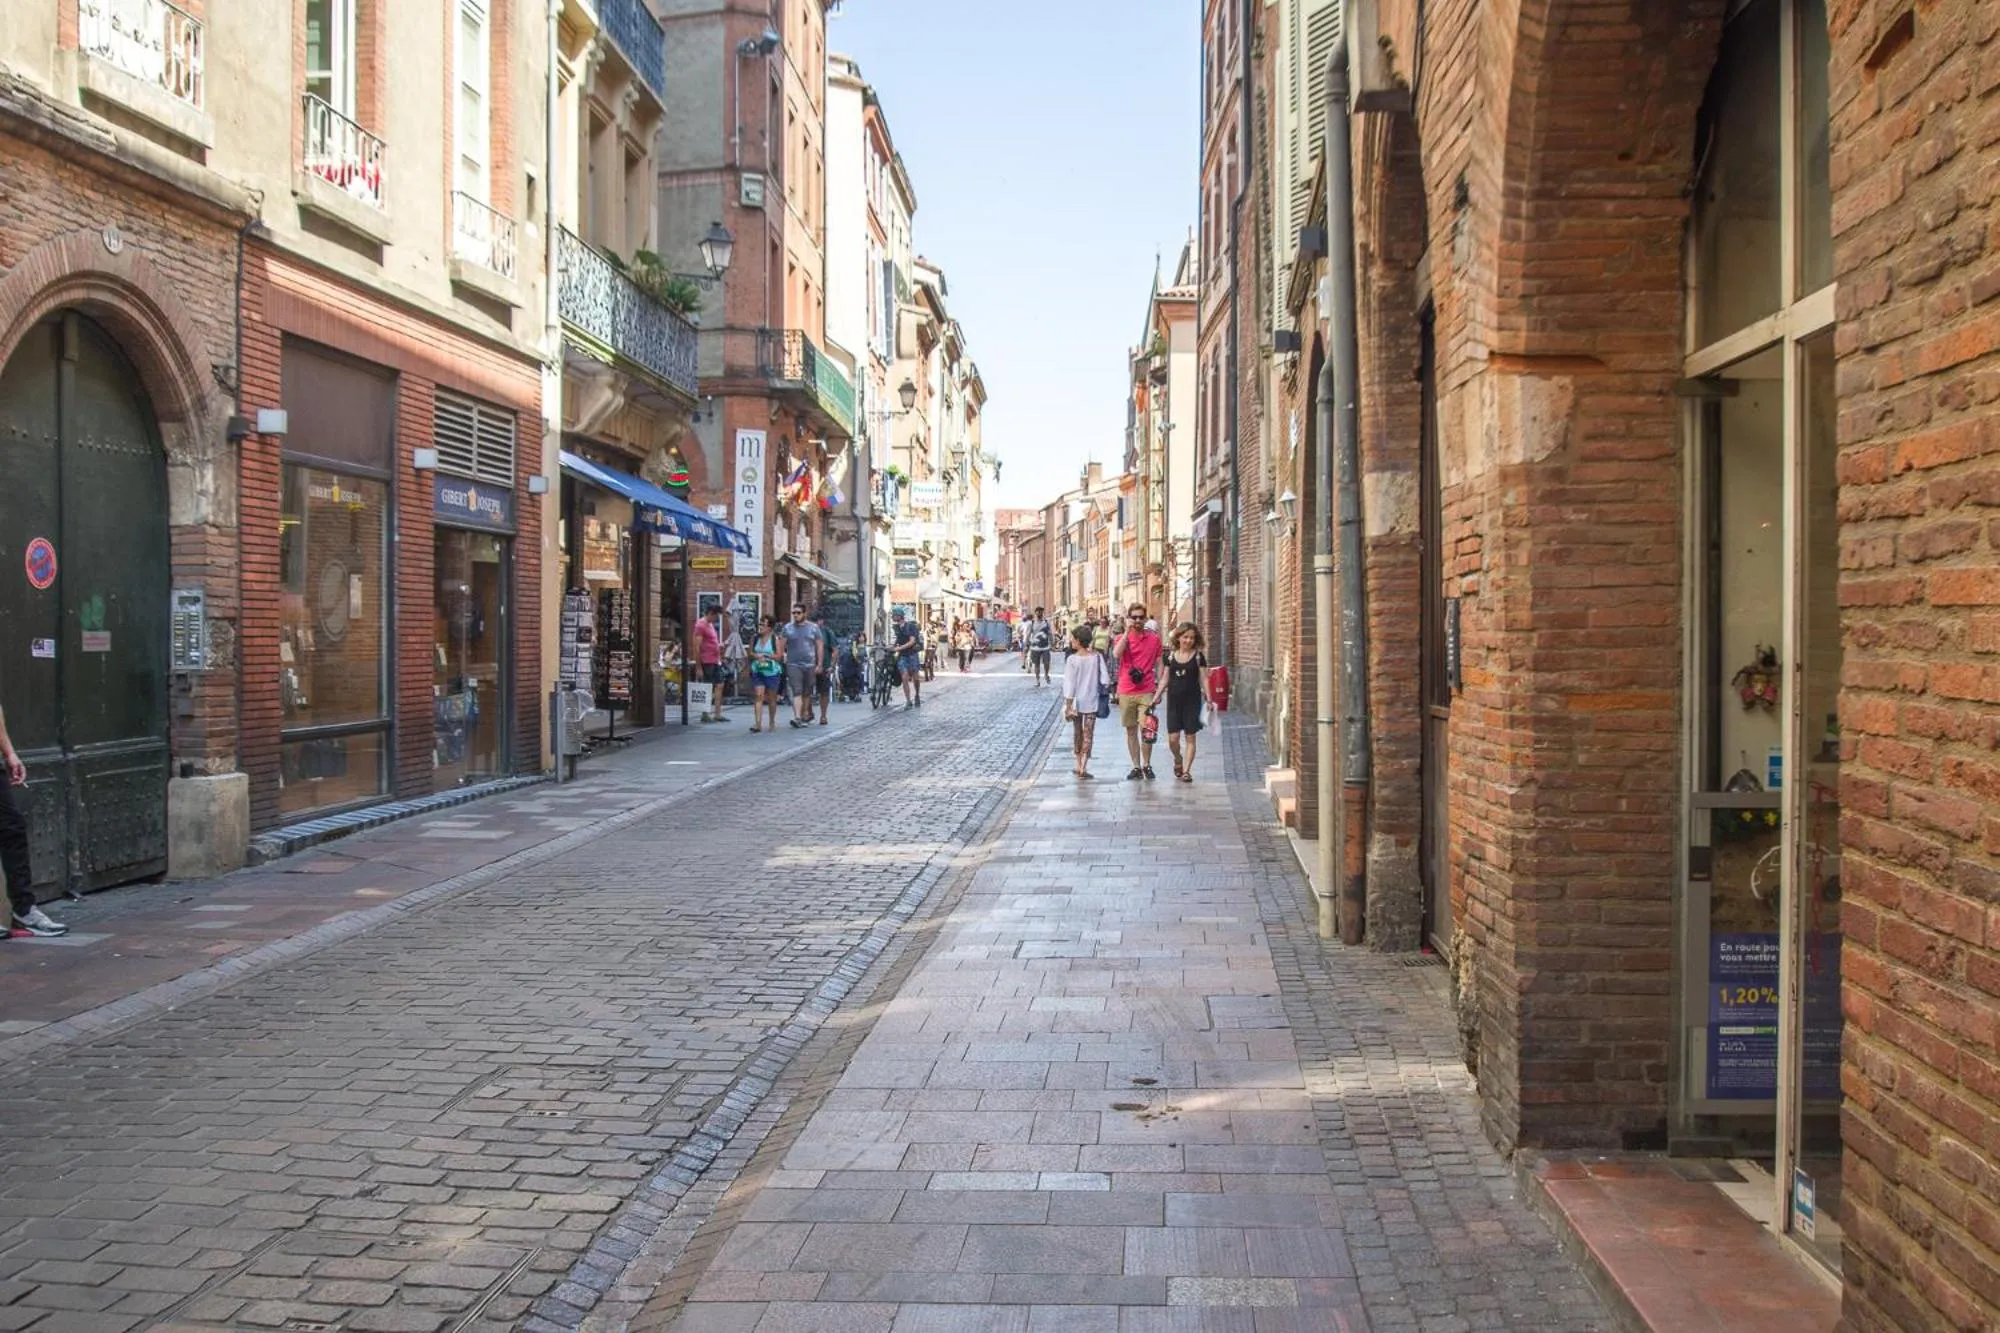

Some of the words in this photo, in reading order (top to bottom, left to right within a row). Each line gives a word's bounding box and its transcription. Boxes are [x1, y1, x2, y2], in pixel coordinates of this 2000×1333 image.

[441, 488, 467, 507] GIBERT
[477, 495, 501, 513] JOSEPH
[1719, 943, 1733, 952] En
[1735, 943, 1761, 952] route
[1719, 953, 1742, 962] vous
[1745, 952, 1776, 962] mettre
[1719, 986, 1778, 1007] 1,20%
